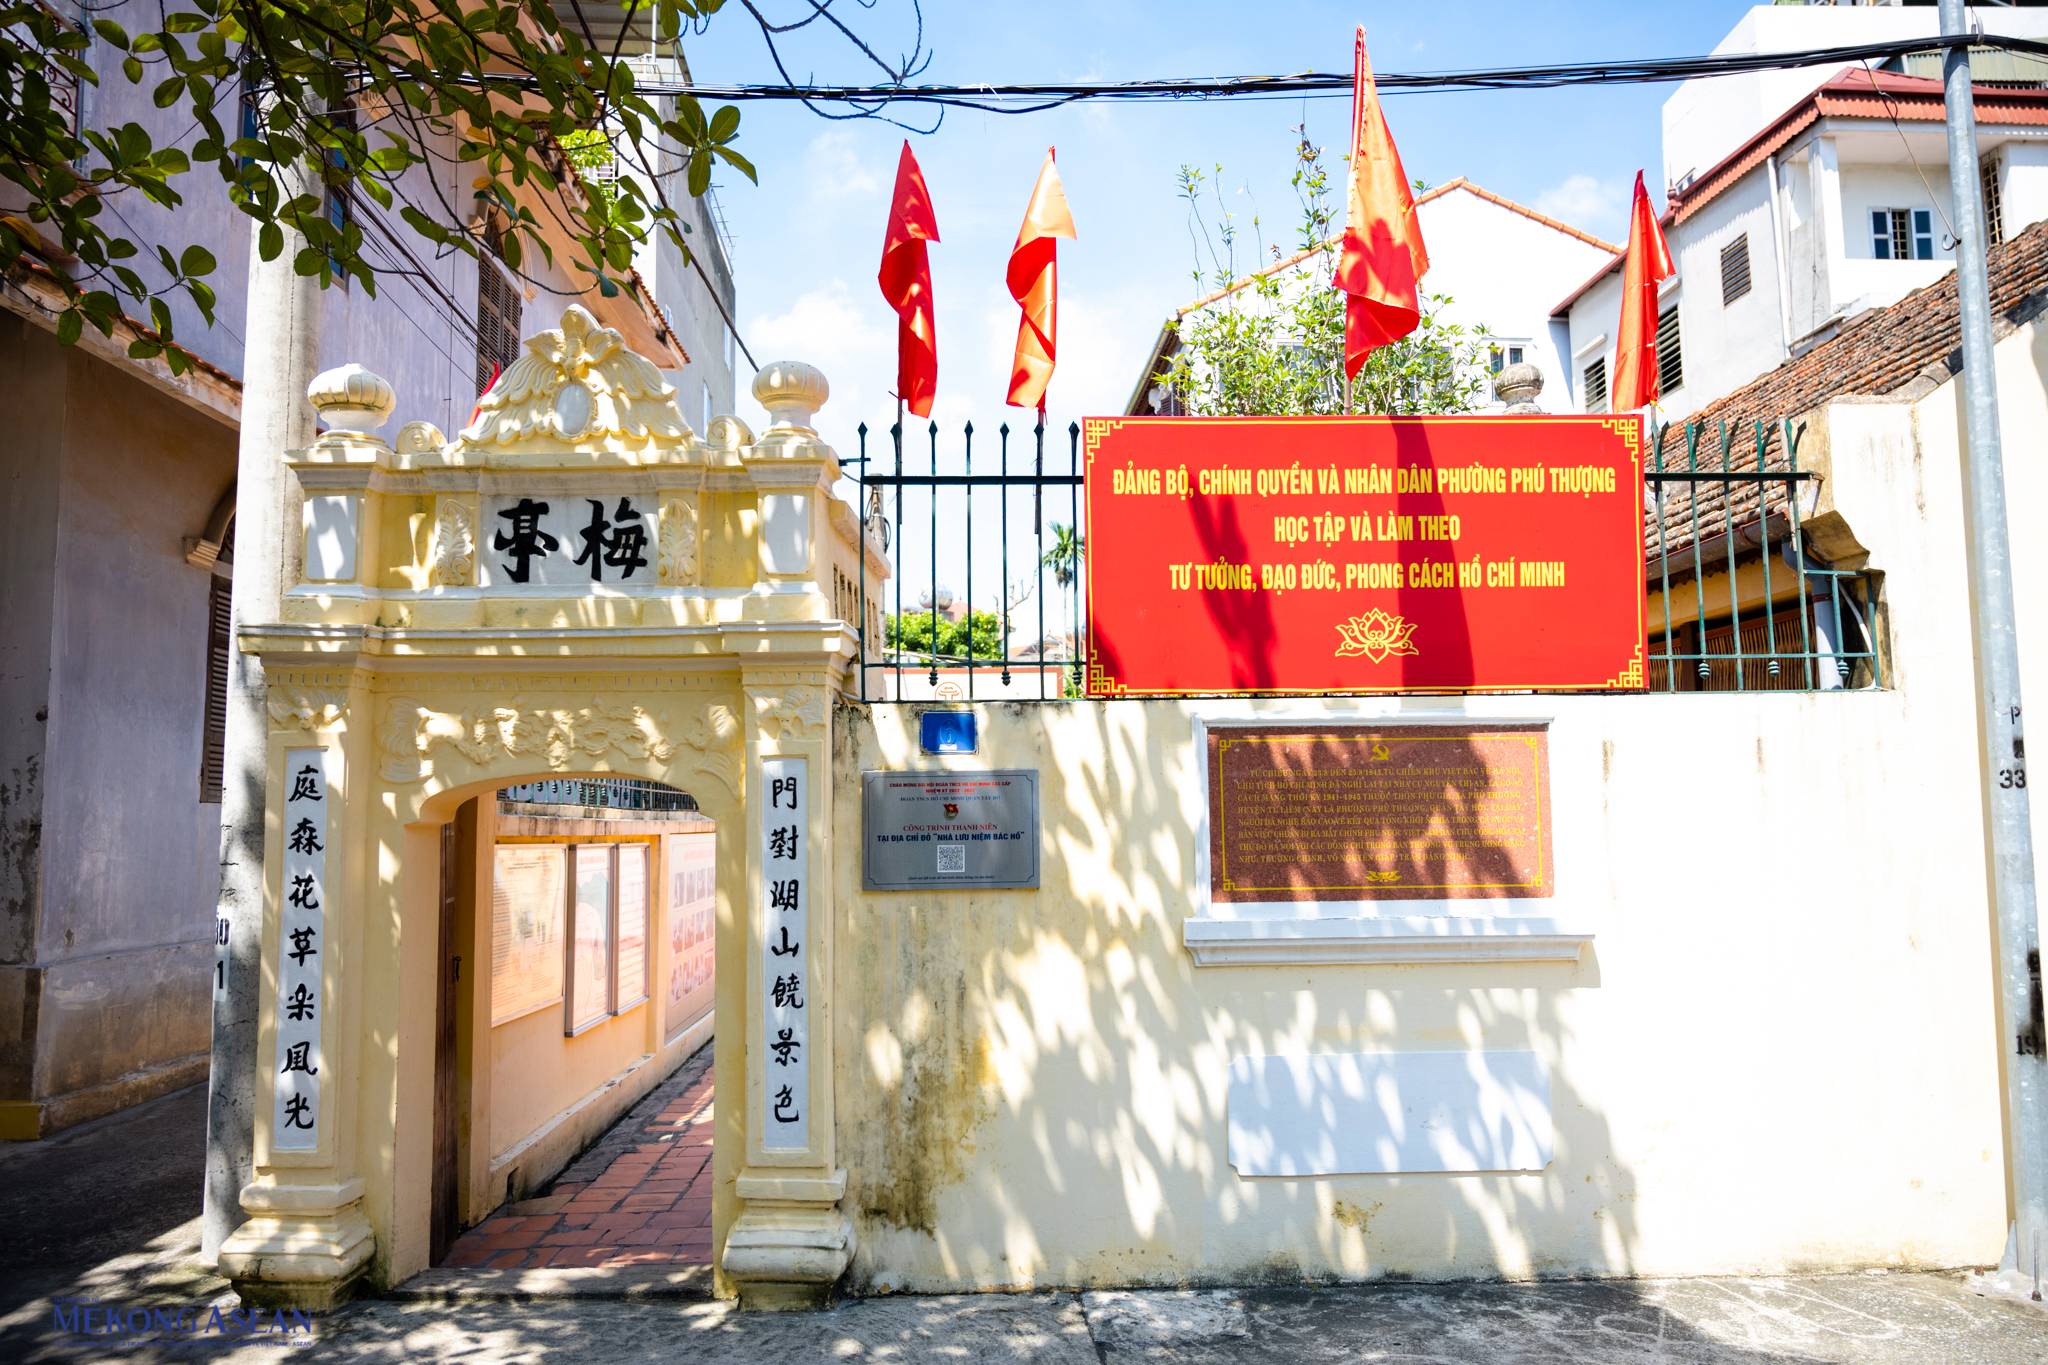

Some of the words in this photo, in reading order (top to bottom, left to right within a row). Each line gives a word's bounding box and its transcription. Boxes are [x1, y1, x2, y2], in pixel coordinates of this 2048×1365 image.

[1113, 461, 1160, 494] ĐẢNG
[1166, 464, 1193, 500] BỘ,
[1200, 464, 1251, 494] CHÍNH
[1257, 461, 1312, 497] QUYỀN
[1318, 464, 1340, 494] VÀ
[1345, 464, 1392, 493] NHÂN
[1398, 464, 1431, 493] DÂN
[1438, 462, 1506, 493] PHƯỜNG
[1512, 463, 1544, 493] PHÚ
[1549, 465, 1615, 498] THƯỢNG
[1275, 517, 1308, 547] HỌC
[1313, 511, 1345, 547] TẬP
[1351, 511, 1372, 541] VÀ
[1377, 511, 1412, 540] LÀM
[1419, 515, 1460, 540] THEO
[1170, 562, 1192, 590] TƯ
[1195, 557, 1256, 592] TƯỞNG,
[1262, 564, 1296, 595] ĐẠO
[1301, 559, 1340, 592] ĐỨC,
[1346, 563, 1403, 588] PHONG
[1410, 558, 1453, 587] CÁCH
[1459, 554, 1481, 587] HỒ
[1487, 557, 1514, 587] CHÍ
[1520, 562, 1564, 586] MINH
[1999, 769, 2027, 789] 33
[877, 835, 889, 843] TẠI
[891, 835, 904, 843] ĐỊA
[972, 832, 991, 842] NIỆM
[993, 832, 1010, 840] BÁC
[903, 823, 925, 831] CÔNG
[927, 823, 950, 831] TRÌNH
